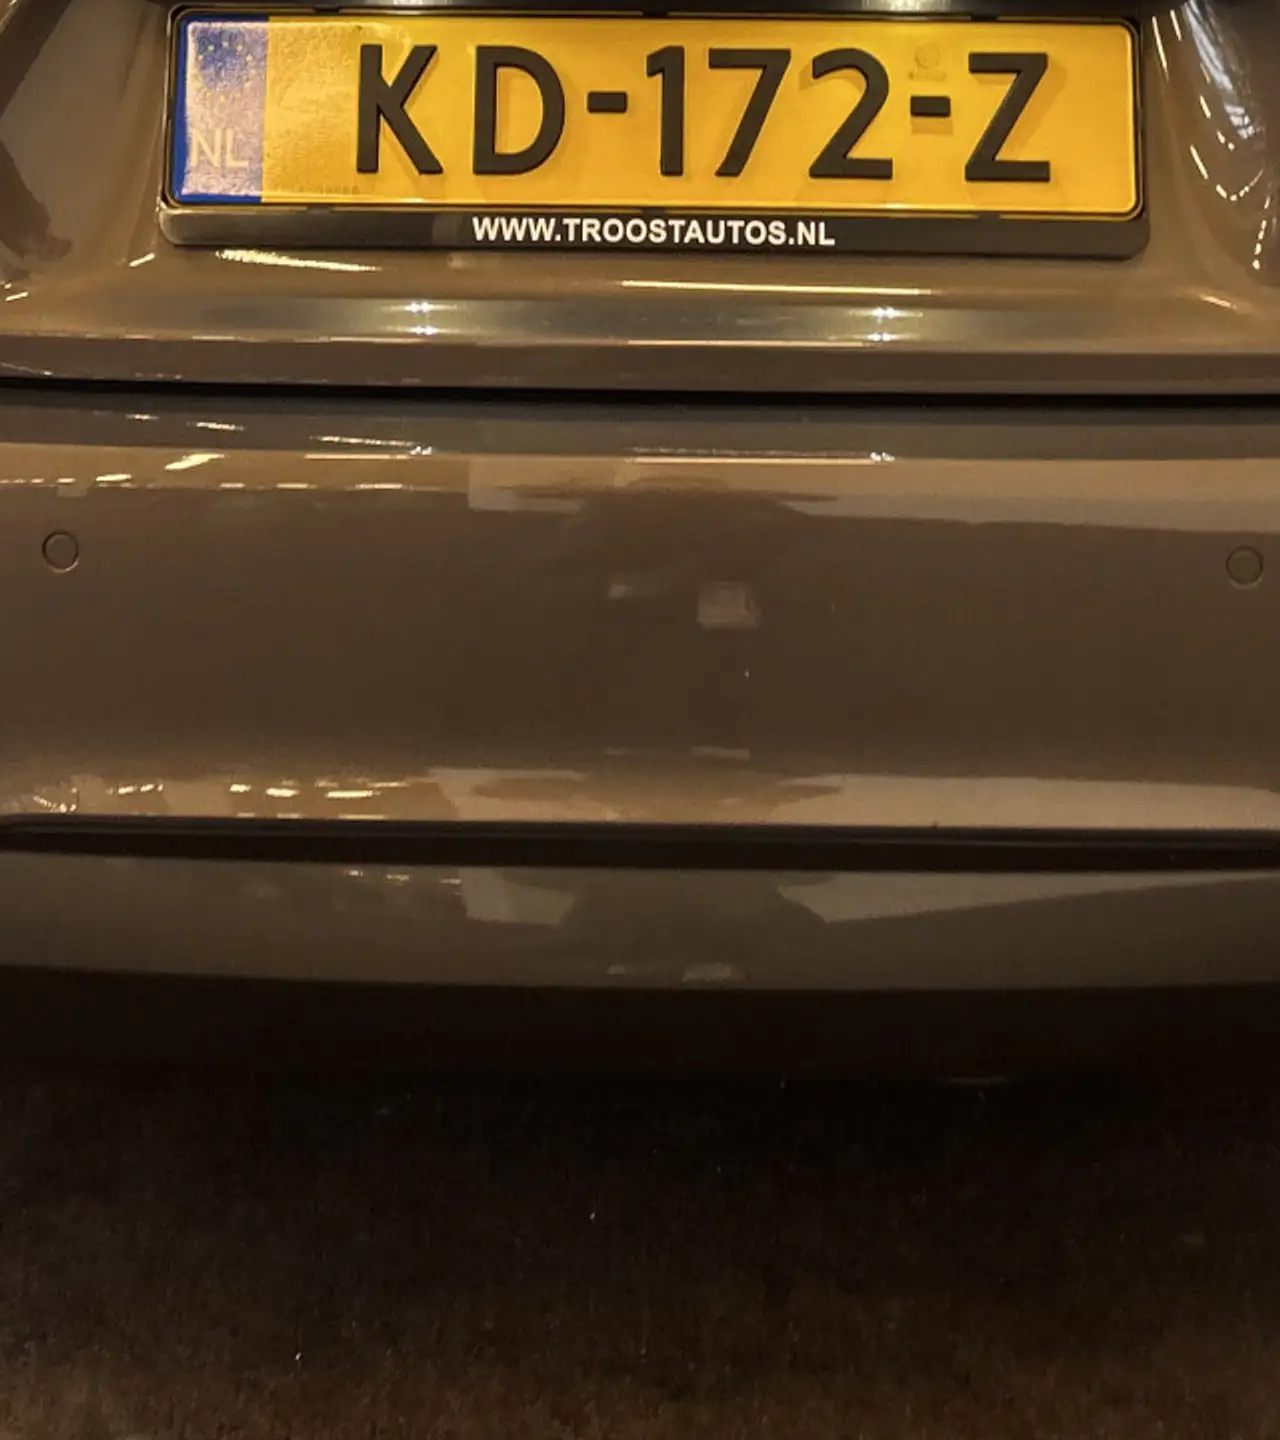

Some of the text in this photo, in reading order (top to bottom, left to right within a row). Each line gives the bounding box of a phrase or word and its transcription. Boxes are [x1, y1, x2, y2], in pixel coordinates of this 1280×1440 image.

[355, 43, 1051, 183] KD-172-Z
[189, 127, 250, 168] NL
[471, 216, 836, 246] WWW.TROOSTAUTOS.NL
